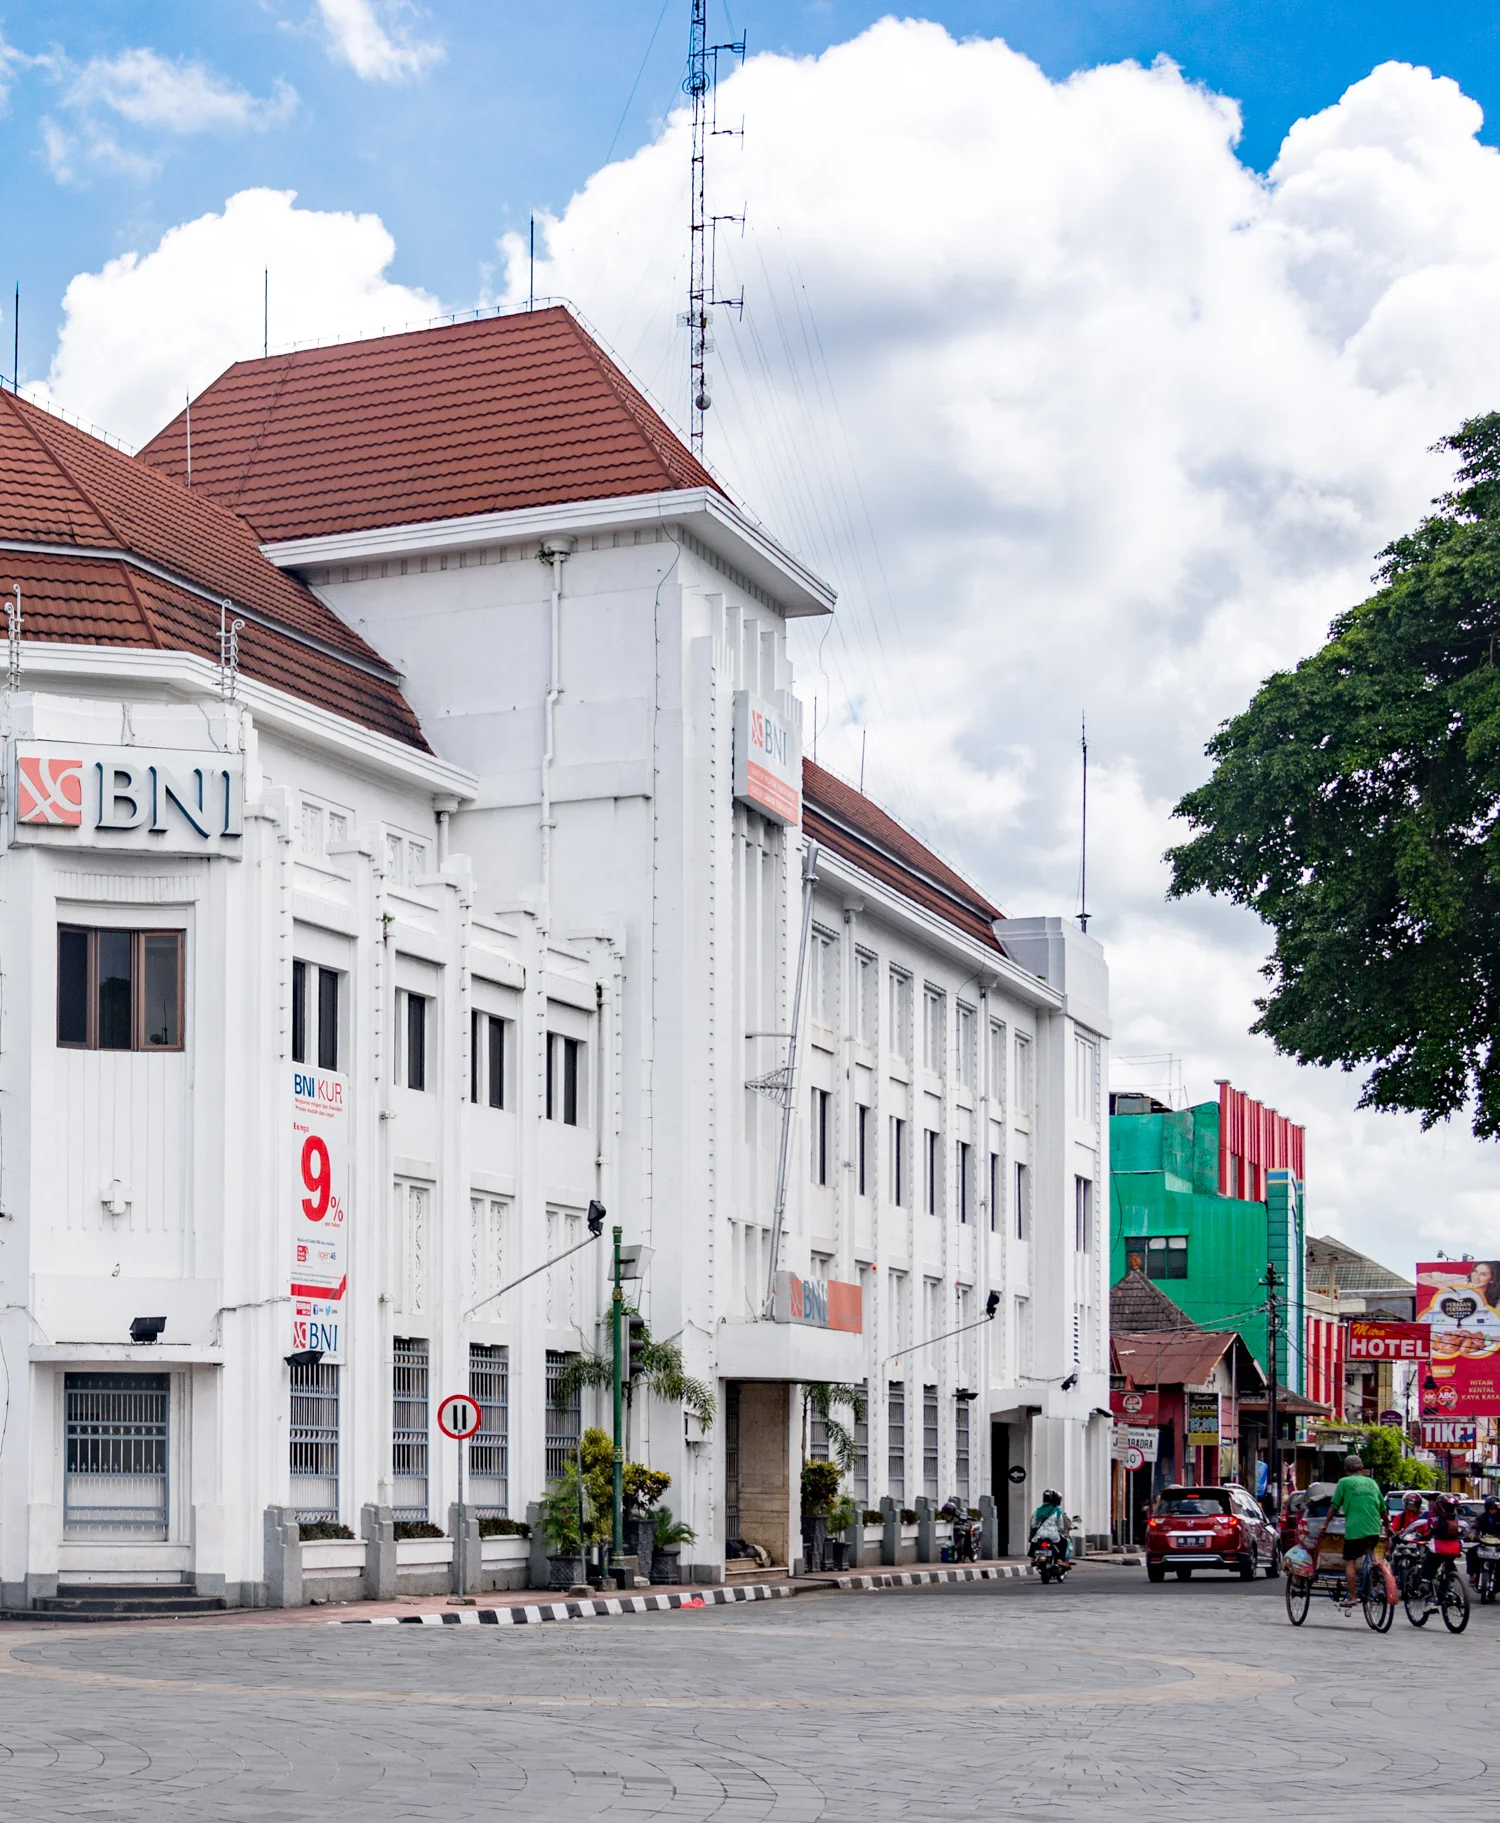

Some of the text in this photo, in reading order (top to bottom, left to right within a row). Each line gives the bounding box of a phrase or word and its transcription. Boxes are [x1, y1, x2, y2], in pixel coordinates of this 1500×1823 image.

[765, 718, 787, 767] BNI
[95, 761, 243, 838] BNI
[294, 1073, 342, 1104] BNI KUR
[803, 1280, 826, 1326] BNI
[310, 1322, 338, 1352] BNI
[1353, 1323, 1386, 1336] Mitra
[1351, 1338, 1429, 1357] HOTEL
[1423, 1423, 1476, 1443] TIKET
